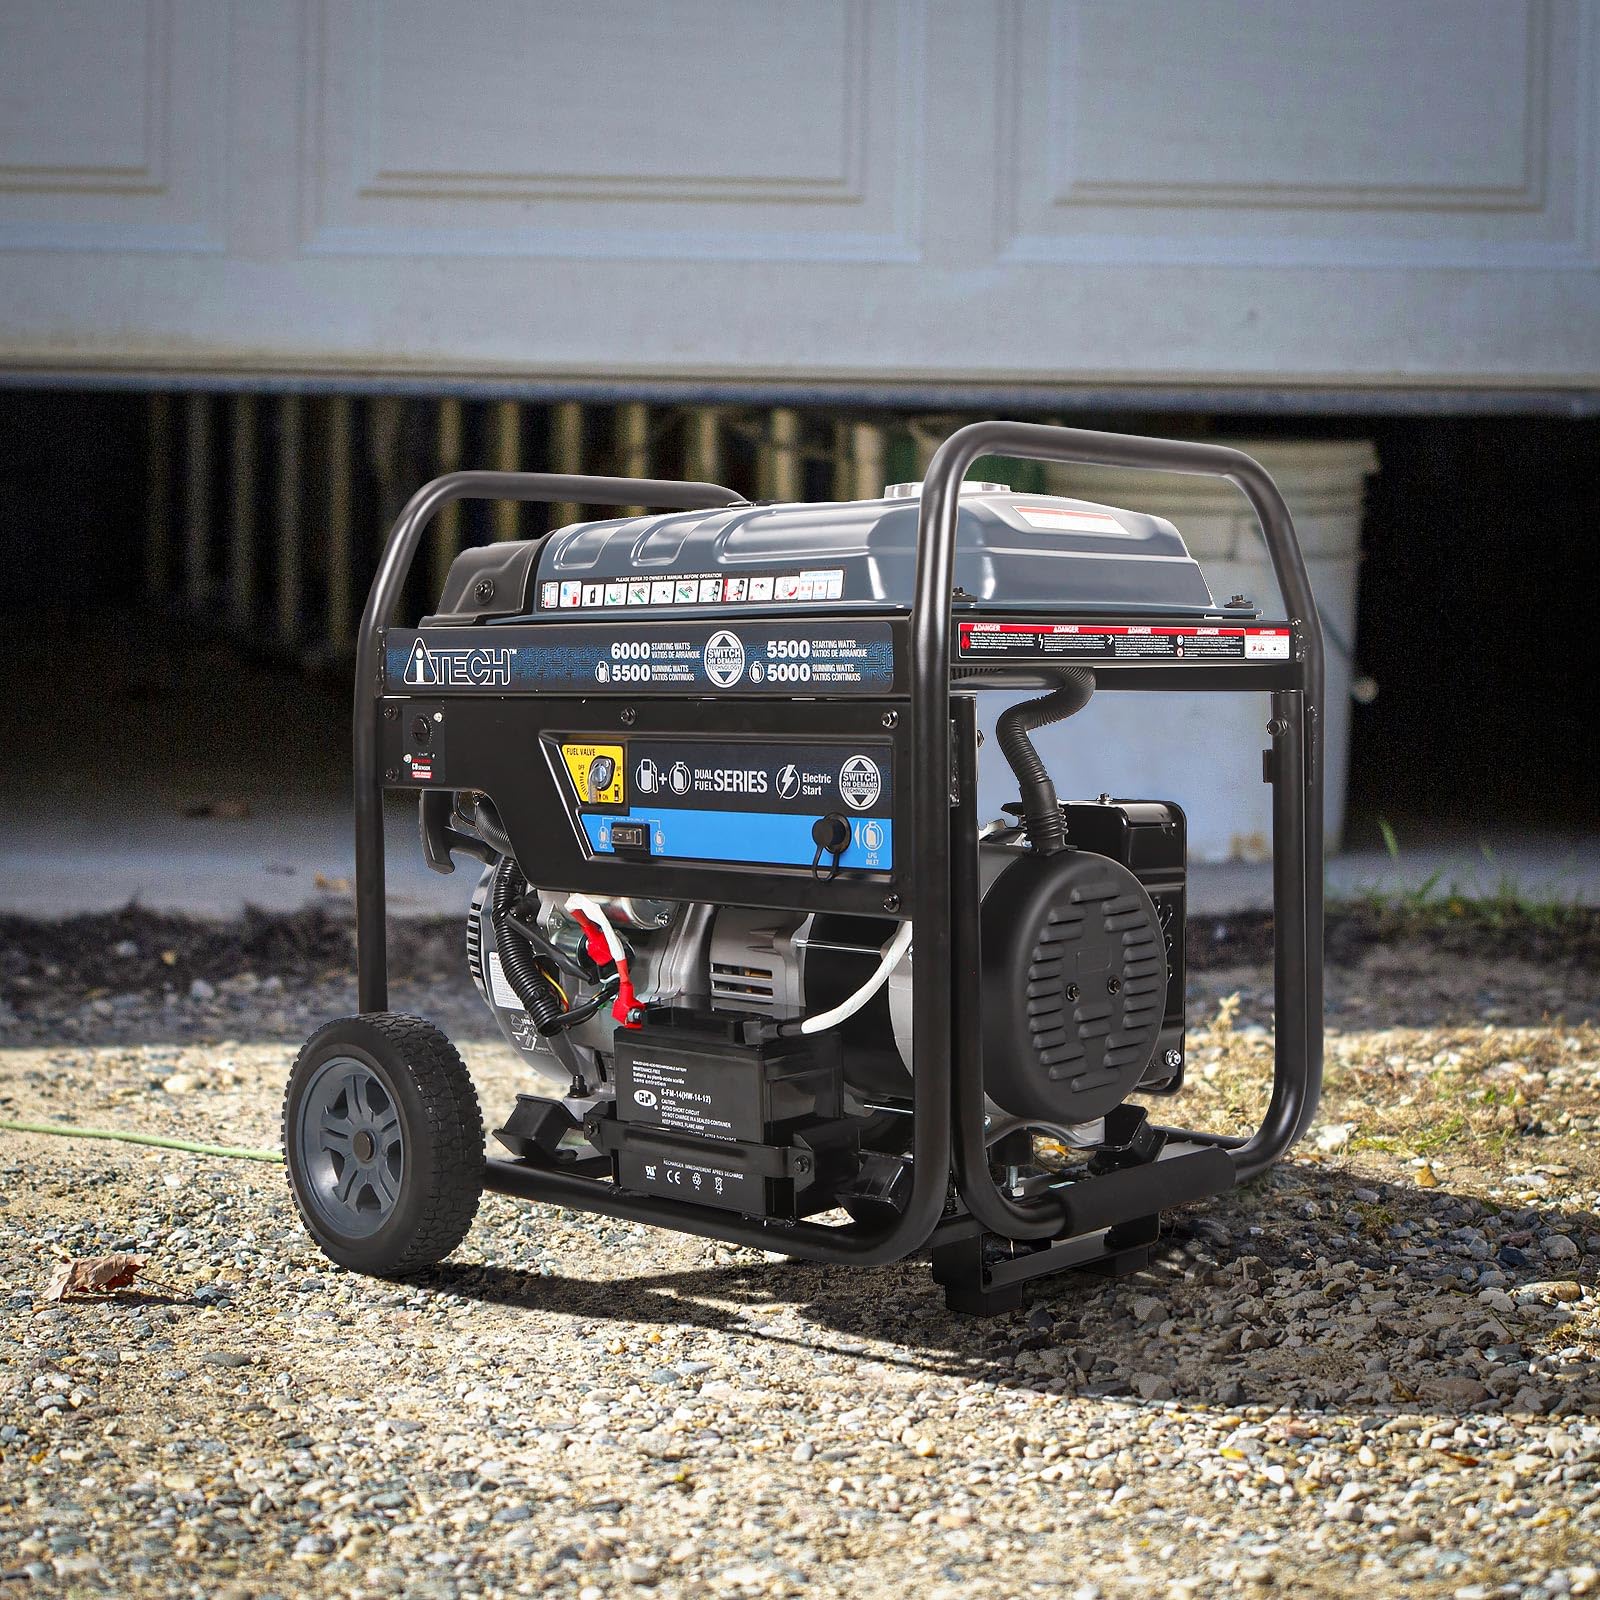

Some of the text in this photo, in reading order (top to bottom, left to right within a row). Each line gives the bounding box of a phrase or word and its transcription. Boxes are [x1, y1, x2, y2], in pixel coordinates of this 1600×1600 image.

[977, 624, 1000, 632] DANGER
[1057, 625, 1079, 633] DANGER
[812, 640, 856, 648] STARTING WATTS
[611, 642, 651, 659] 6000
[708, 649, 741, 658] SWITCH
[767, 640, 810, 658] 5500
[812, 649, 867, 658] VATIOS DE ARRANQUE
[612, 664, 651, 681] 5500
[652, 673, 668, 681] VATIOS
[767, 664, 811, 681] 5000
[812, 673, 831, 681] VATIOS
[566, 748, 595, 756] FUEL VALVE
[695, 769, 713, 779] DUAL
[802, 773, 831, 783] Electric
[843, 773, 877, 782] SWITCH
[695, 781, 713, 790] FUEL
[714, 769, 768, 793] SERIES
[802, 785, 822, 795] Start
